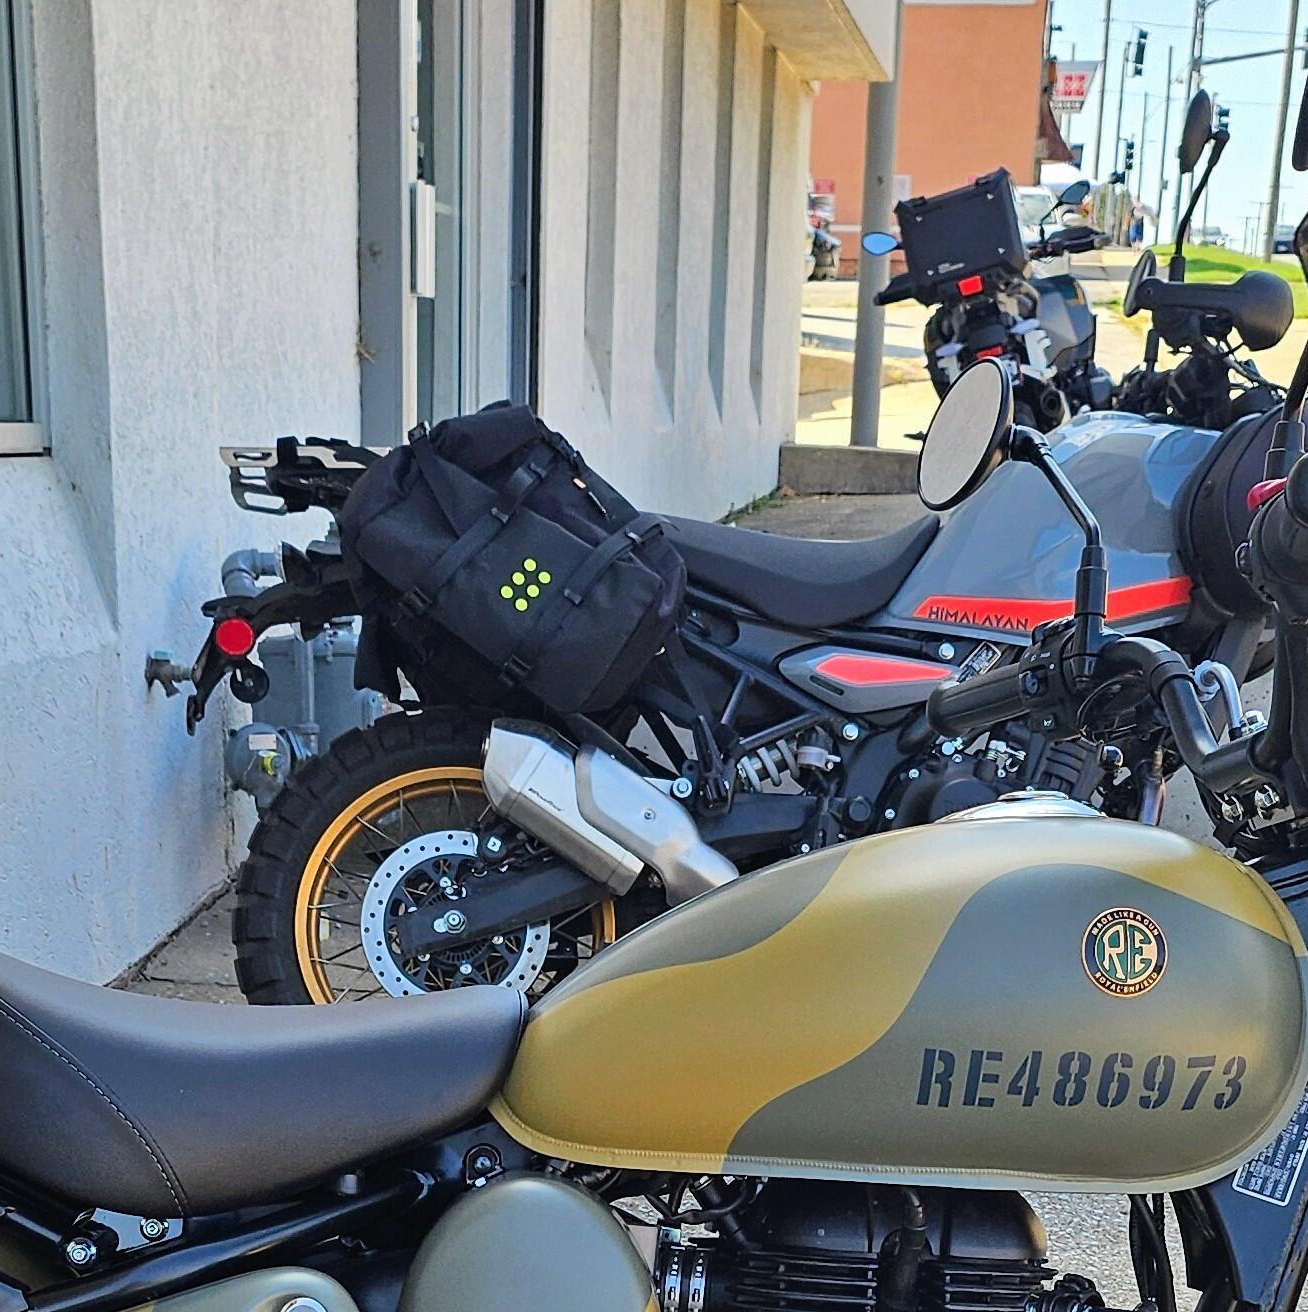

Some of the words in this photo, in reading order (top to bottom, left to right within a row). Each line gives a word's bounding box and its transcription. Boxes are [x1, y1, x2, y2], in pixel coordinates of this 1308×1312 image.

[928, 605, 1030, 631] HIMALAYAN
[1091, 914, 1113, 935] MADE
[1114, 911, 1134, 919] LIKE
[1135, 914, 1142, 922] A
[1143, 918, 1159, 935] GUN
[1102, 923, 1153, 980] RE
[1094, 971, 1121, 992] ROYAL
[1123, 972, 1158, 993] ENFIELD
[916, 1048, 1248, 1112] RE486973
